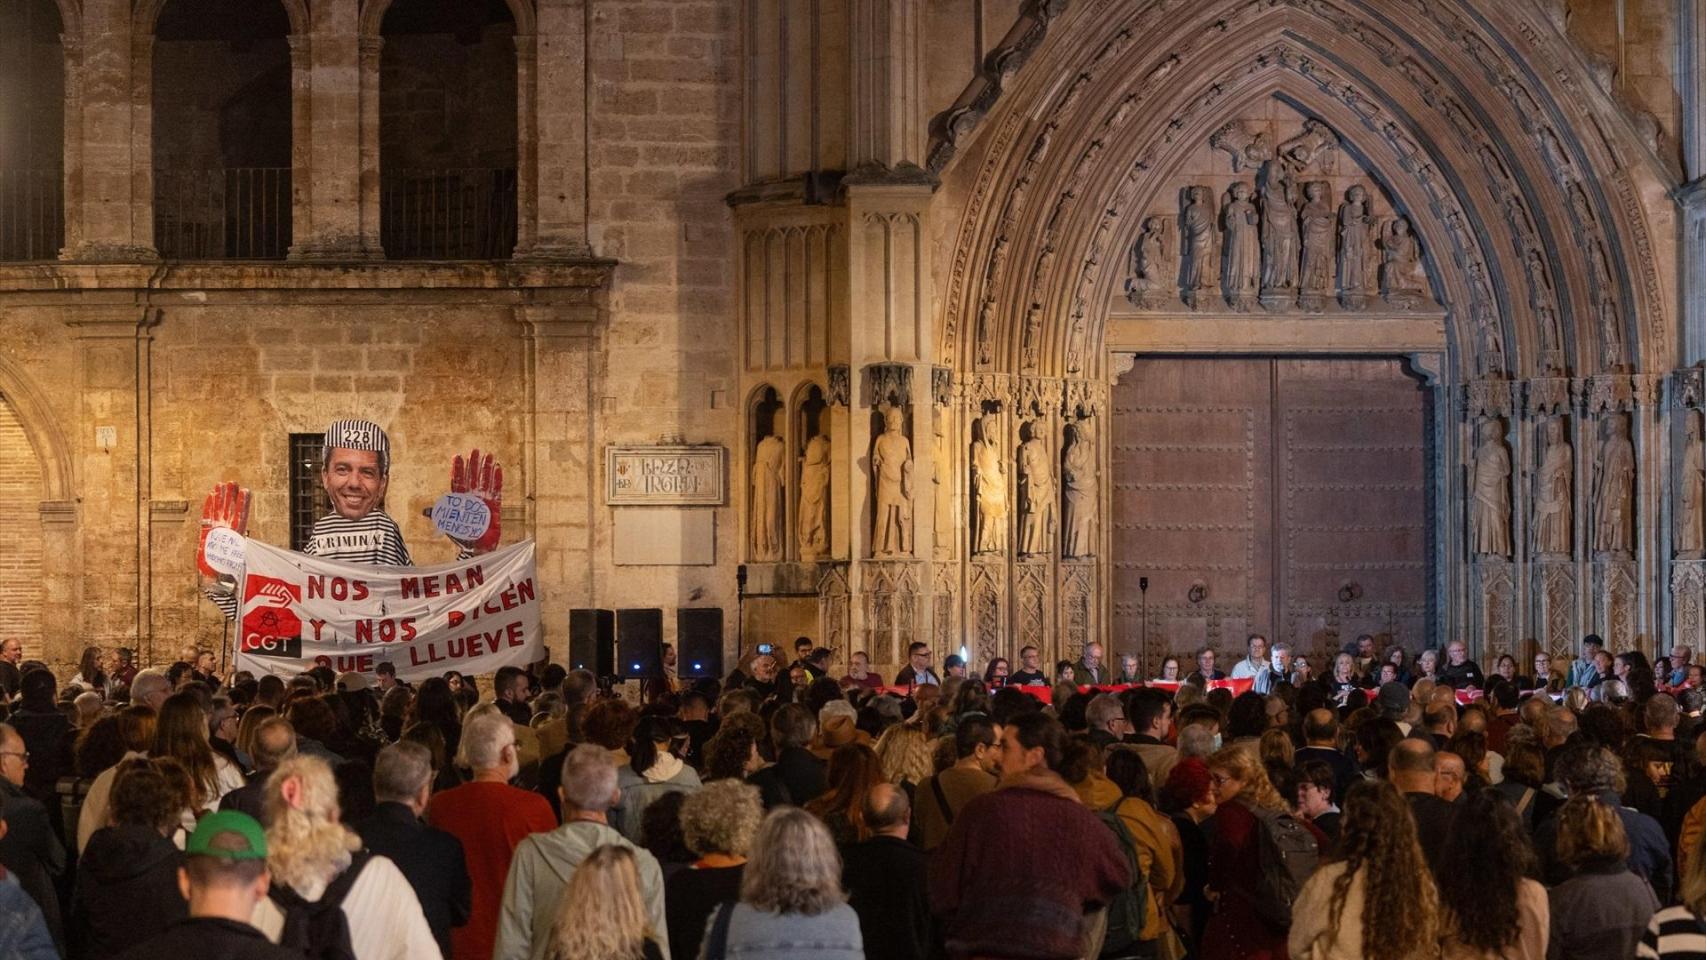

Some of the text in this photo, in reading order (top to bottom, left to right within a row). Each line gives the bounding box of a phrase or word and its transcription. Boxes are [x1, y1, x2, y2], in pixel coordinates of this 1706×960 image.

[344, 430, 370, 443] 228
[435, 506, 487, 525] MIENTEN
[307, 565, 484, 601] NOS MEAN
[309, 577, 535, 644] Y NOS DICEN
[246, 632, 292, 652] CGT
[410, 621, 525, 667] LLUEVE
